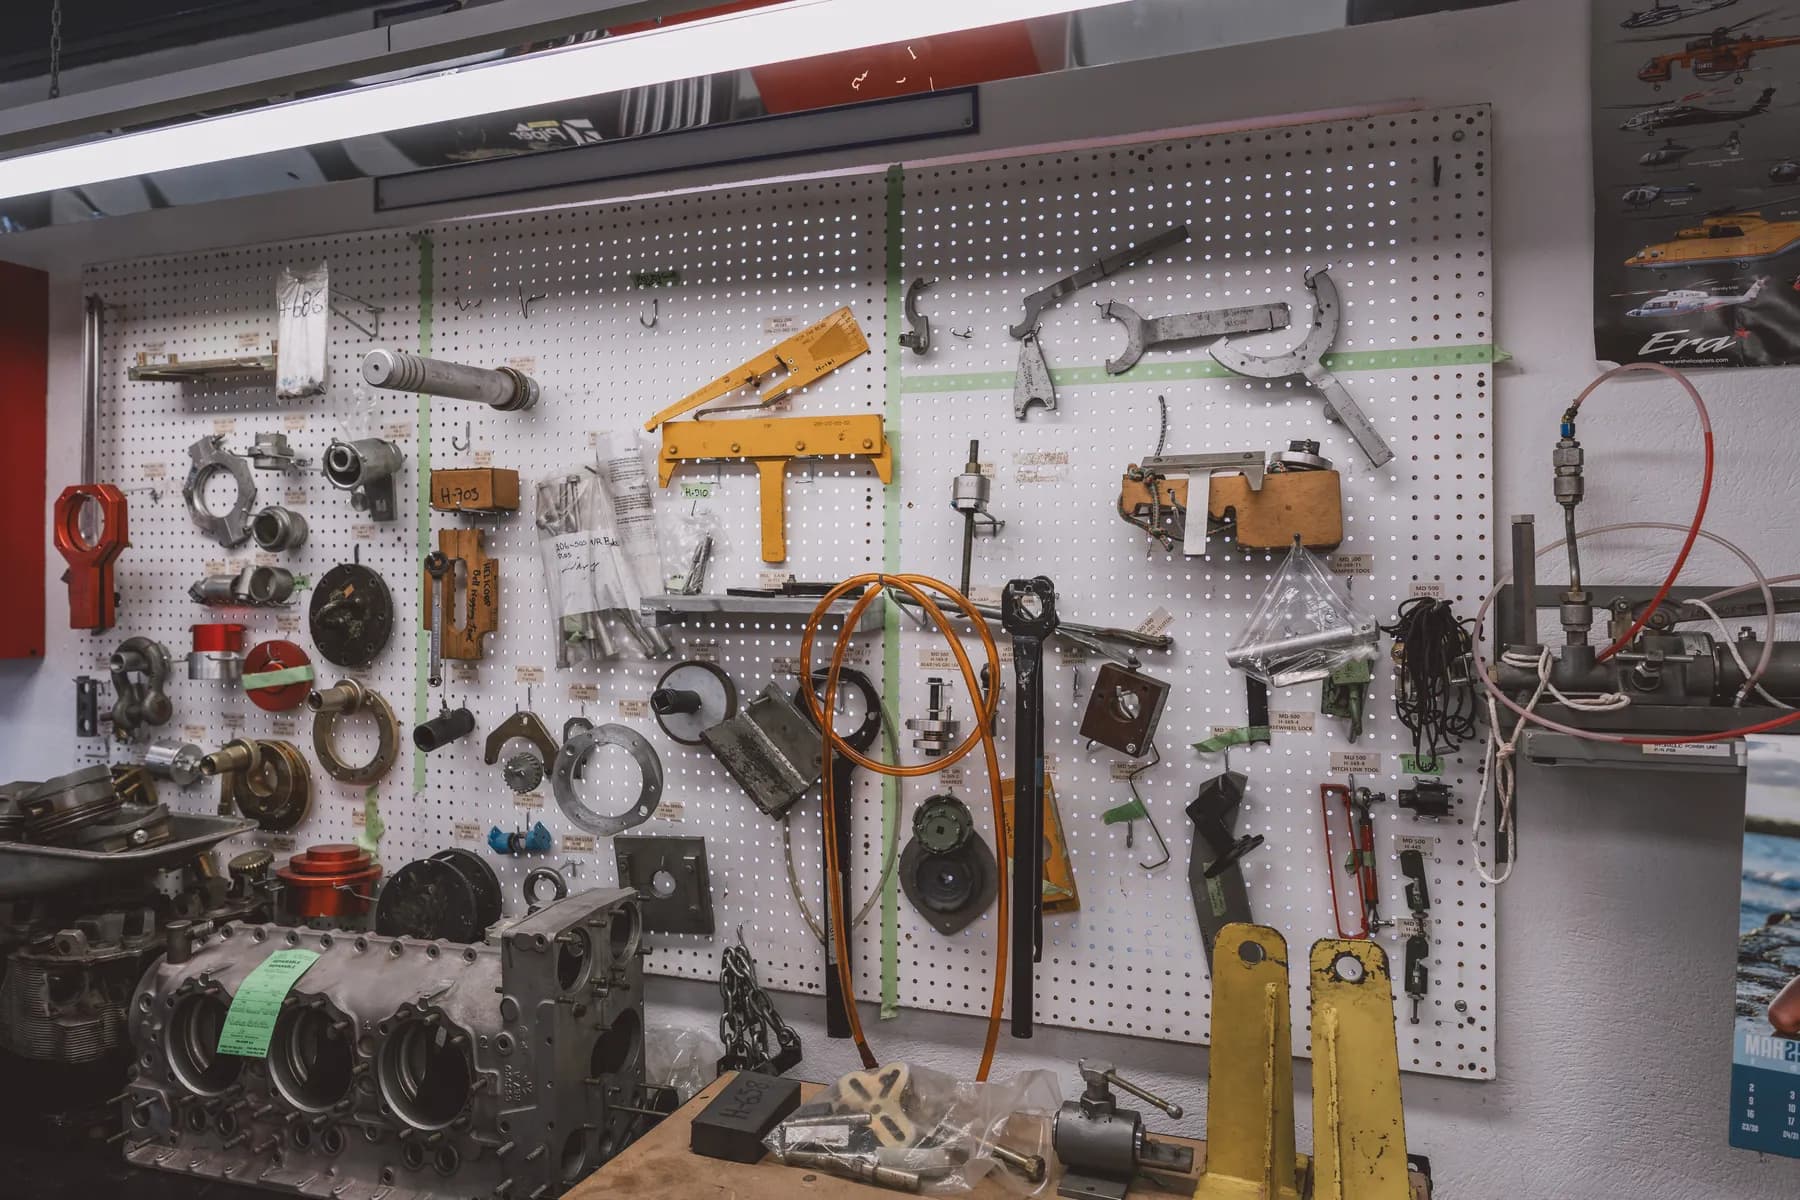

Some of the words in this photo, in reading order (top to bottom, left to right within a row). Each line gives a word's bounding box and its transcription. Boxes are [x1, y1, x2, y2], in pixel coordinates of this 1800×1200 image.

[1638, 329, 1737, 355] Era
[1748, 1083, 1755, 1092] 2
[1790, 1090, 1796, 1100] 3
[1748, 1096, 1754, 1106] 9
[1788, 1103, 1796, 1113] 10
[1746, 1109, 1755, 1119] 16
[1788, 1116, 1796, 1126] 17
